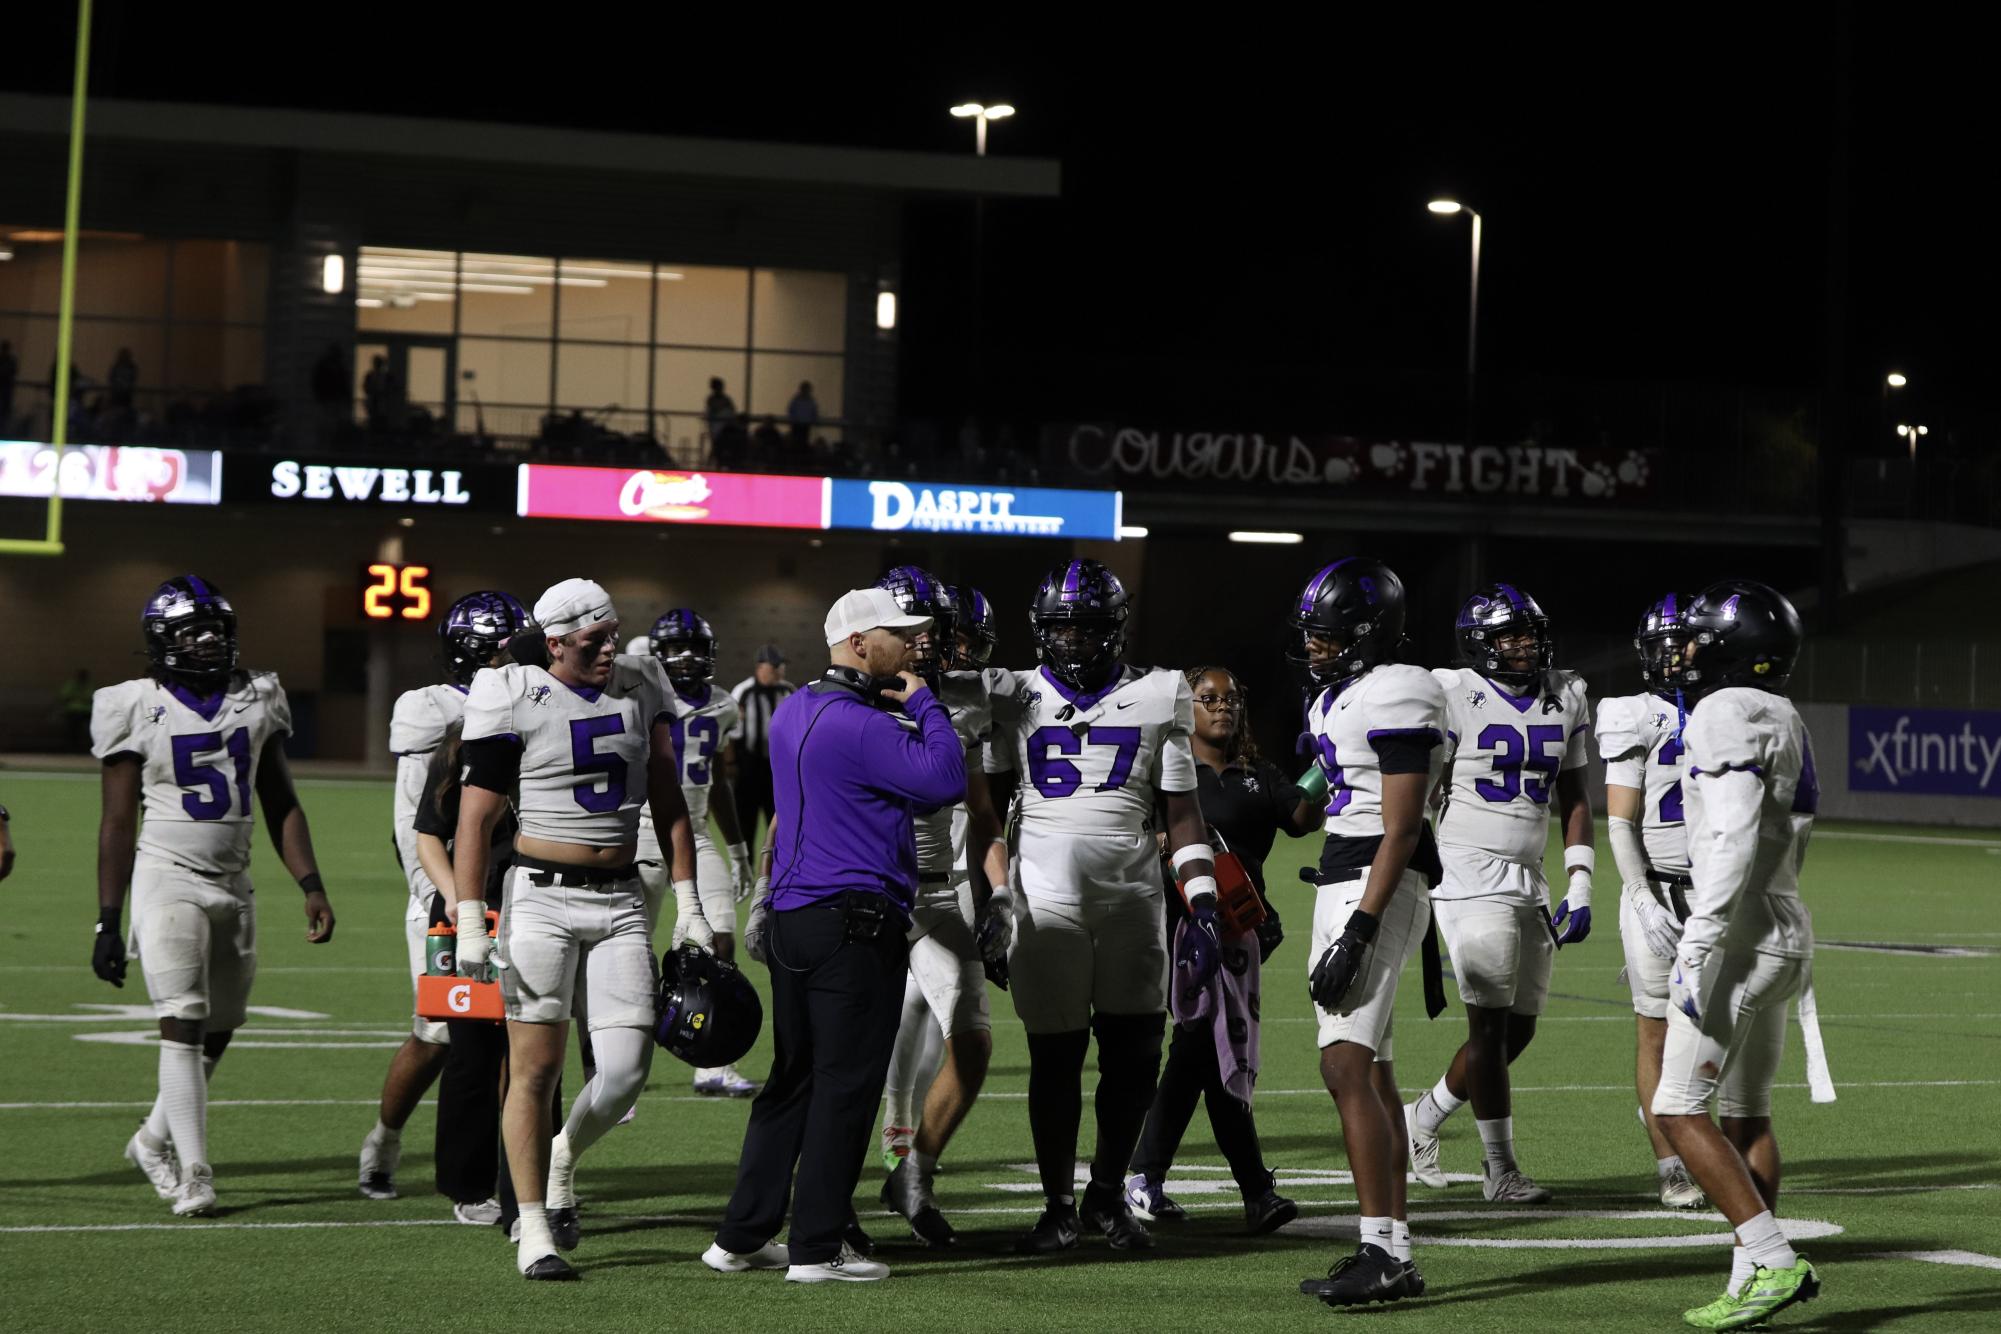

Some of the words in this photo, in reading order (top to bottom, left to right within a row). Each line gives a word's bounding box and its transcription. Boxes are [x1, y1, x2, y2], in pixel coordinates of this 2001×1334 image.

[271, 460, 471, 504] SEWELL
[1068, 424, 1323, 484] Cougars
[1408, 441, 1578, 497] FIGHT
[868, 481, 1015, 530] DASPIT
[364, 564, 431, 619] 25
[1720, 593, 1741, 621] 4
[171, 726, 251, 821] 51
[569, 713, 628, 814] 5
[1027, 726, 1141, 799] 67
[1475, 724, 1564, 804] 35
[1857, 716, 2001, 789] xfinity
[447, 984, 471, 1013] G
